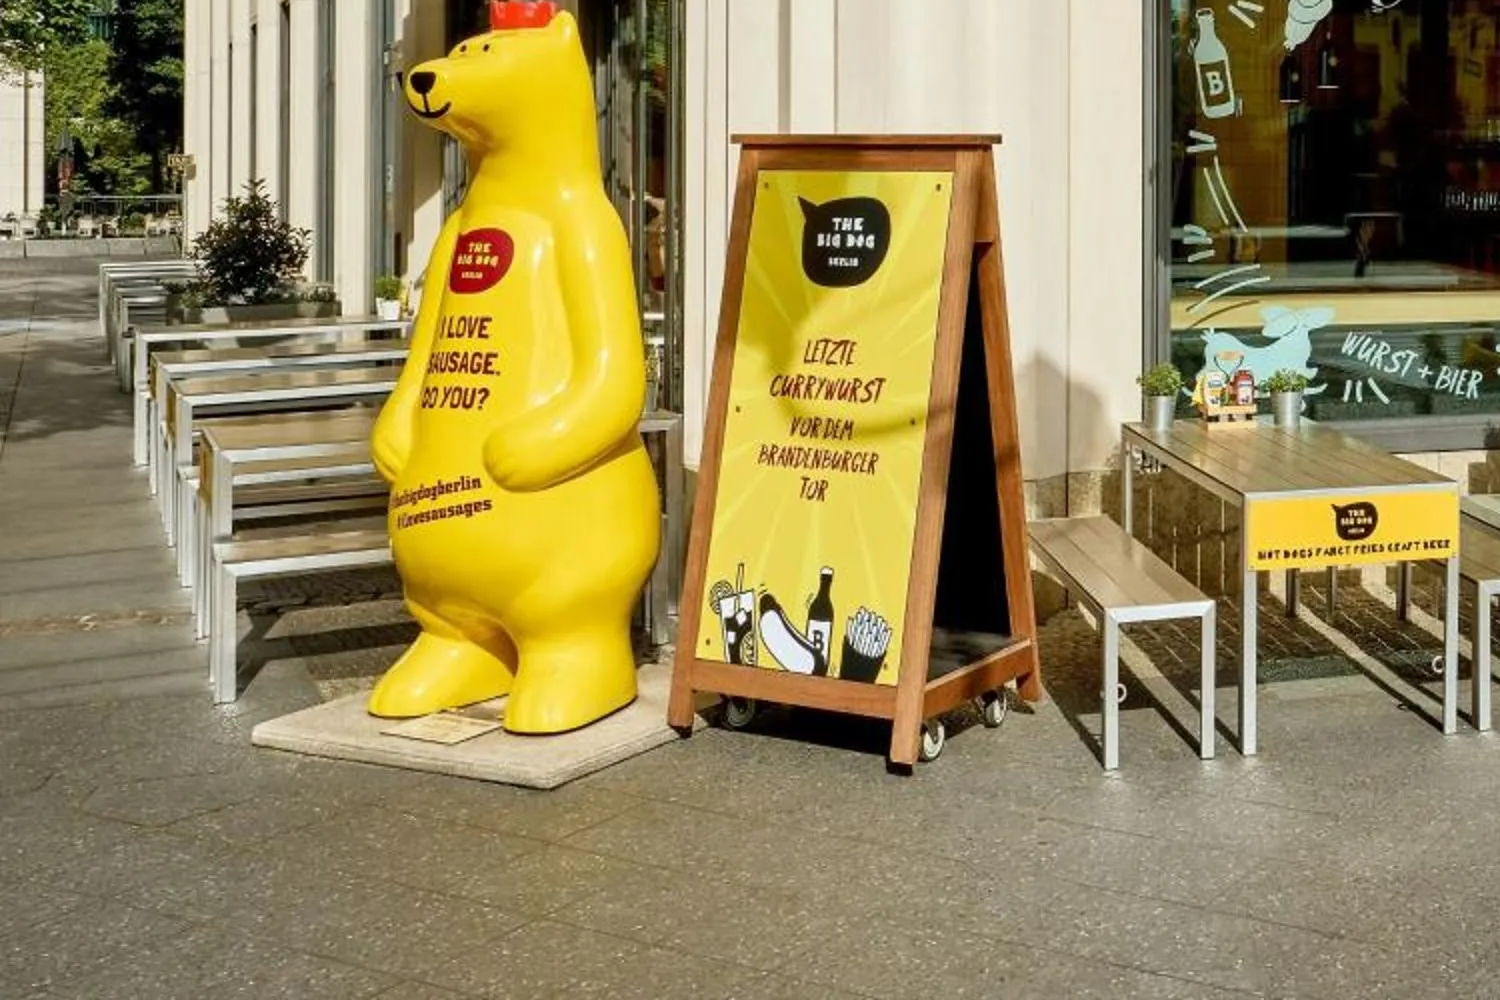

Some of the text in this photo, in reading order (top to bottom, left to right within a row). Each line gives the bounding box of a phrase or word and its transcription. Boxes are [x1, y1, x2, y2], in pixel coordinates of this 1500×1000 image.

[832, 217, 865, 231] THE
[817, 233, 875, 249] BIG DOG
[447, 315, 493, 338] LOVE
[803, 338, 858, 366] LETZTE
[1341, 330, 1419, 380] WURST
[1435, 364, 1484, 400] BIER
[421, 385, 491, 411] DO YOU?
[769, 373, 887, 404] CURRYWURST
[789, 415, 855, 441] VOR DEM
[757, 443, 880, 475] BRANDENBURGER
[800, 476, 830, 502] TOR
[813, 629, 825, 651] B
